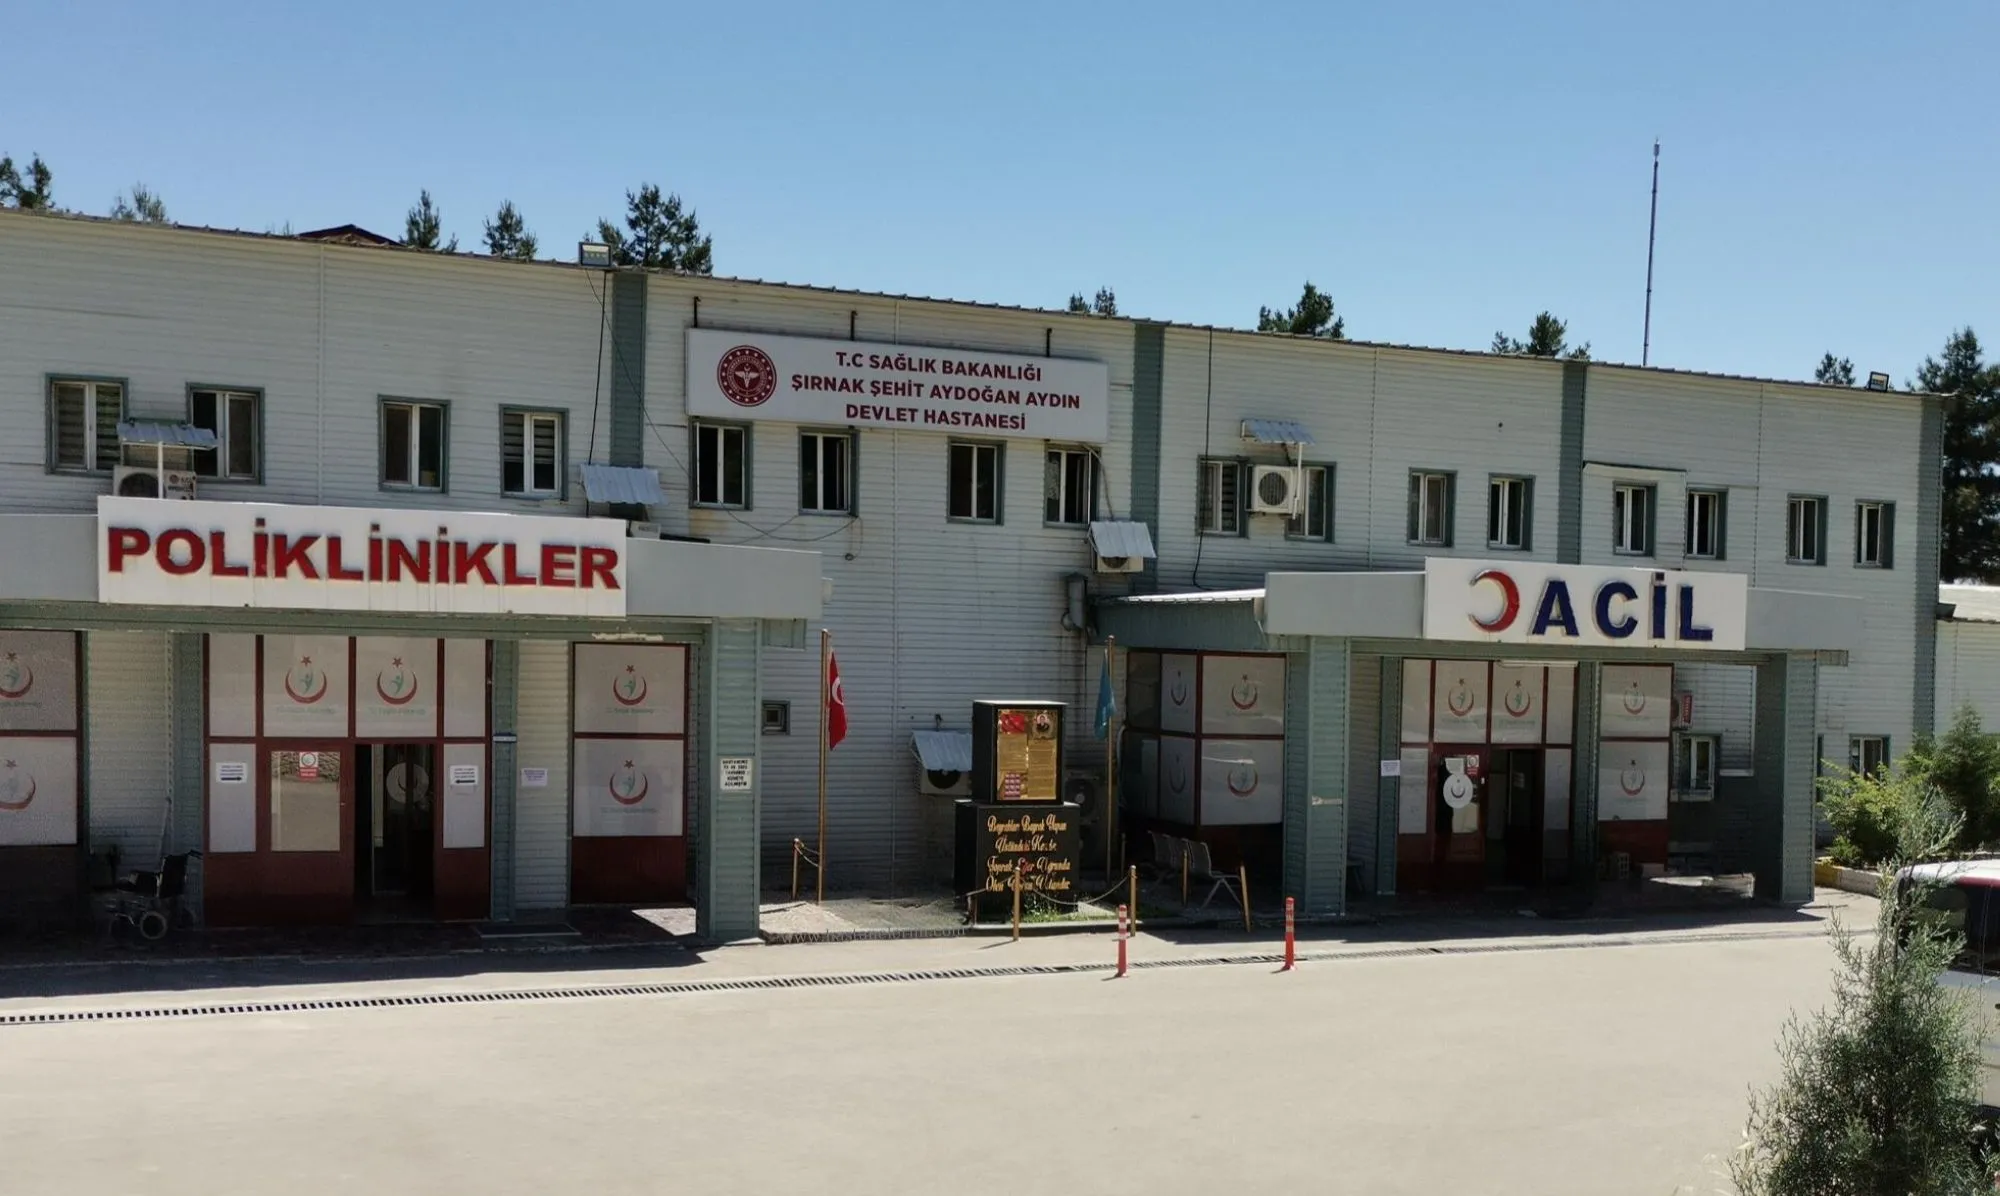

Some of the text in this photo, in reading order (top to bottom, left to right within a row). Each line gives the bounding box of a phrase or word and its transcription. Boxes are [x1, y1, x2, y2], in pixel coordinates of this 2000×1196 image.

[836, 351, 1042, 382] T.C SAĞLIK BAKANLIĞI
[791, 374, 865, 394] ŞIRNAK
[870, 379, 925, 399] ŞEHİT
[929, 384, 1021, 406] AYDOĞAN
[1025, 392, 1081, 410] AYDIN
[845, 403, 1027, 431] DEVLET HASTANESİ
[107, 516, 621, 591] POLİKLİNİKLER
[1529, 571, 1715, 641] ACİL
